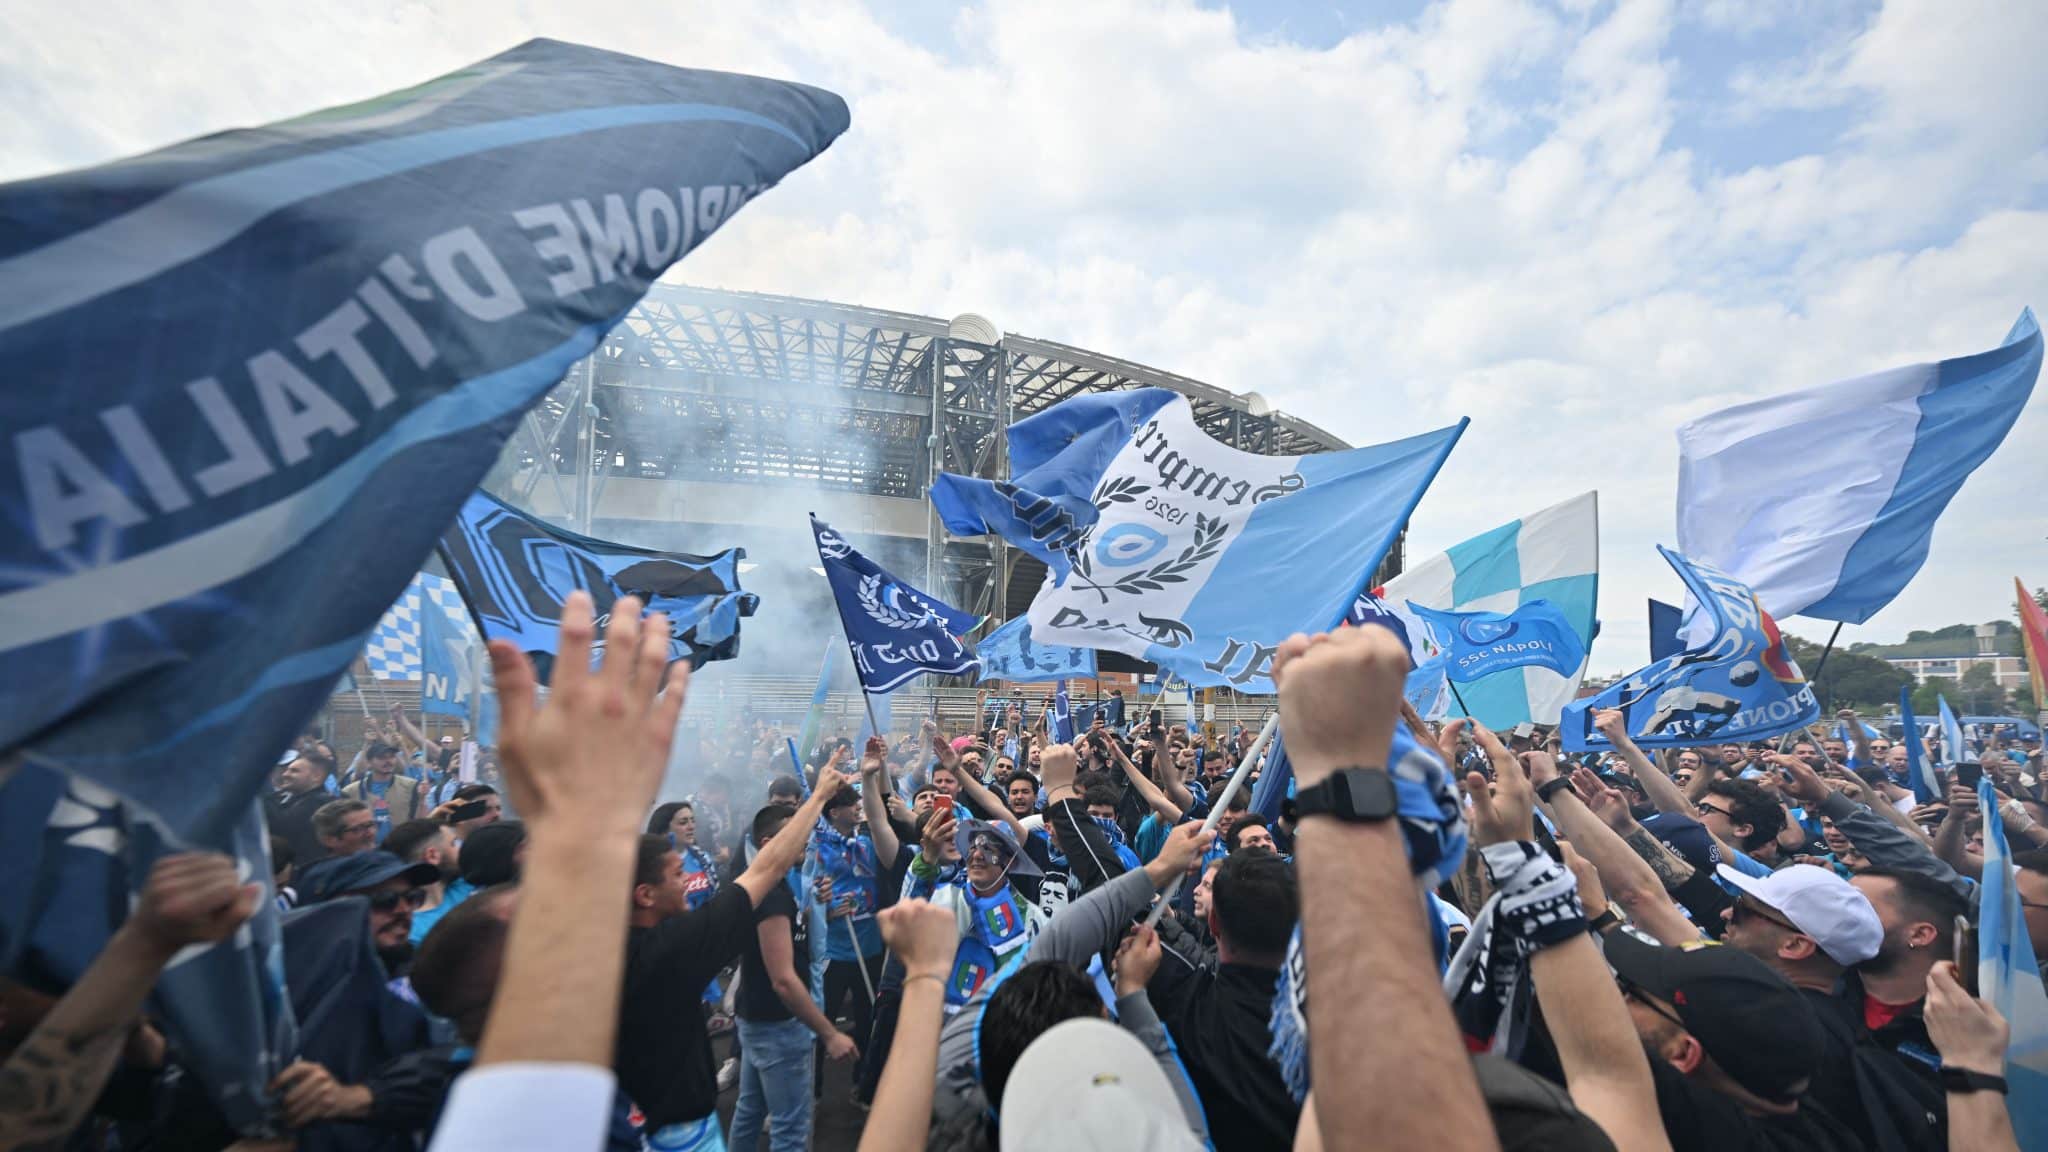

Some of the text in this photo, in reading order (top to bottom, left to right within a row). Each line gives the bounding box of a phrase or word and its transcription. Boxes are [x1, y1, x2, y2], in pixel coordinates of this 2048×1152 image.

[872, 639, 940, 664] Tuo
[1459, 650, 1489, 668] SSC
[1492, 639, 1553, 654] NAPOLI
